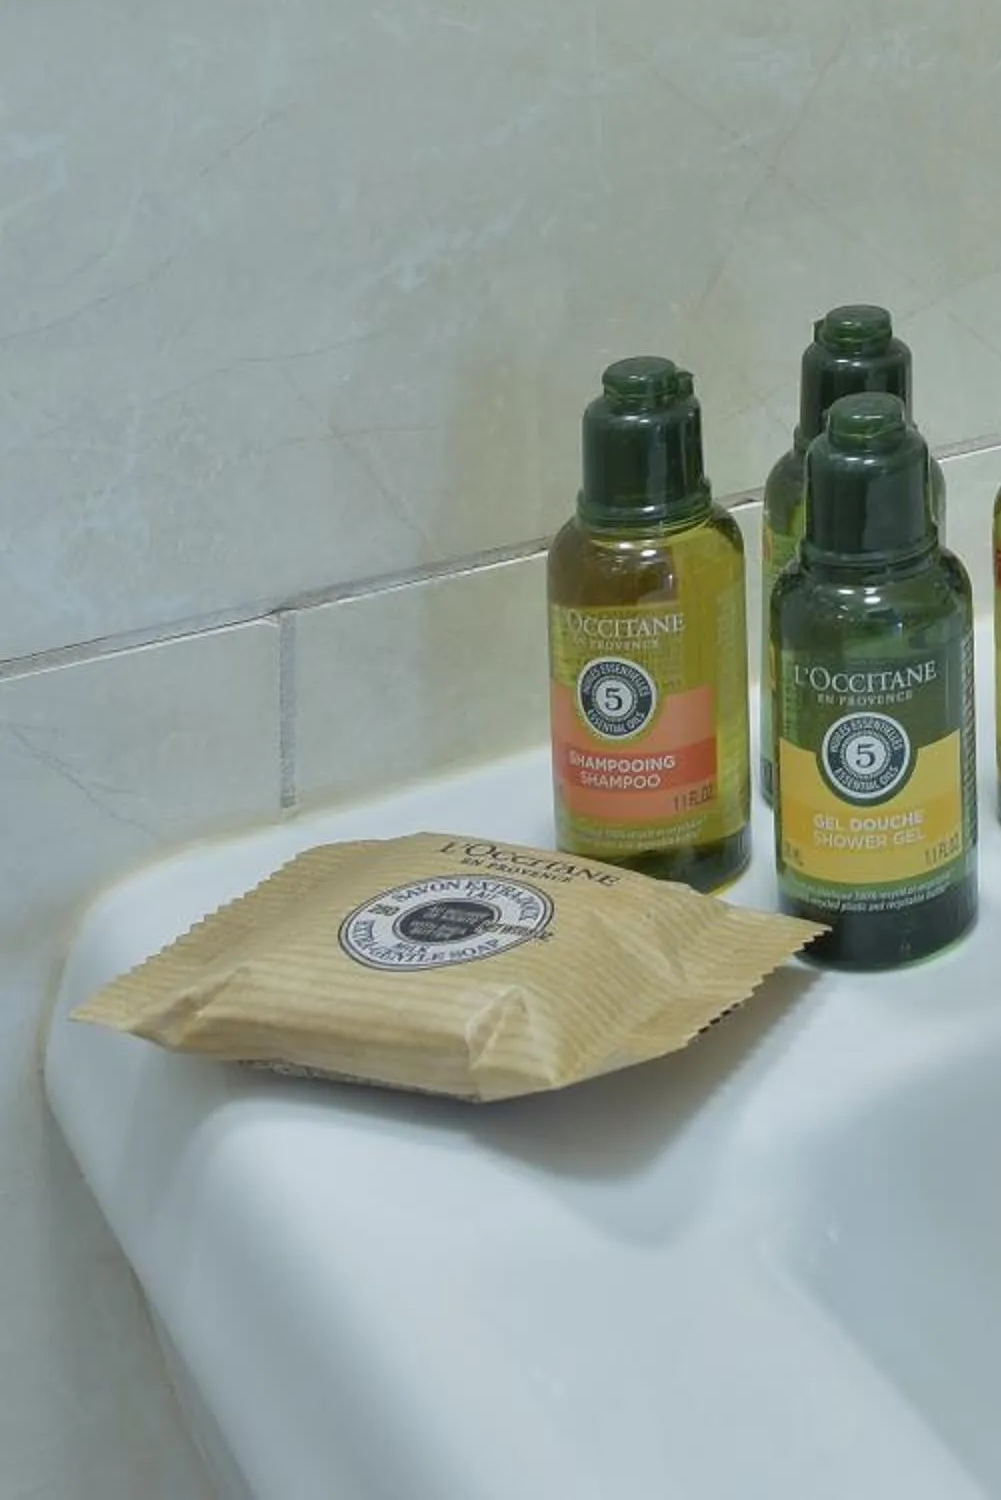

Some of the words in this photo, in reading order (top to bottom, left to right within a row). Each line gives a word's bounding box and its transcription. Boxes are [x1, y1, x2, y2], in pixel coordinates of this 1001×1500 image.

[566, 608, 686, 638] OCCITANE
[794, 659, 937, 693] L'OCCITANE
[604, 687, 623, 711] 5
[817, 693, 834, 705] EN
[838, 690, 913, 707] PROVENCE
[568, 749, 676, 773] SHAMPOOING
[855, 743, 876, 768] 5
[579, 770, 662, 789] SHAMPOO
[812, 813, 844, 831] GEL
[850, 810, 924, 832] DOUCHE
[813, 830, 887, 849] SHOWER
[892, 828, 927, 845] GEL
[438, 841, 622, 887] L'OCCITANE
[391, 880, 461, 902] SAVON
[449, 938, 500, 959] SOAP
